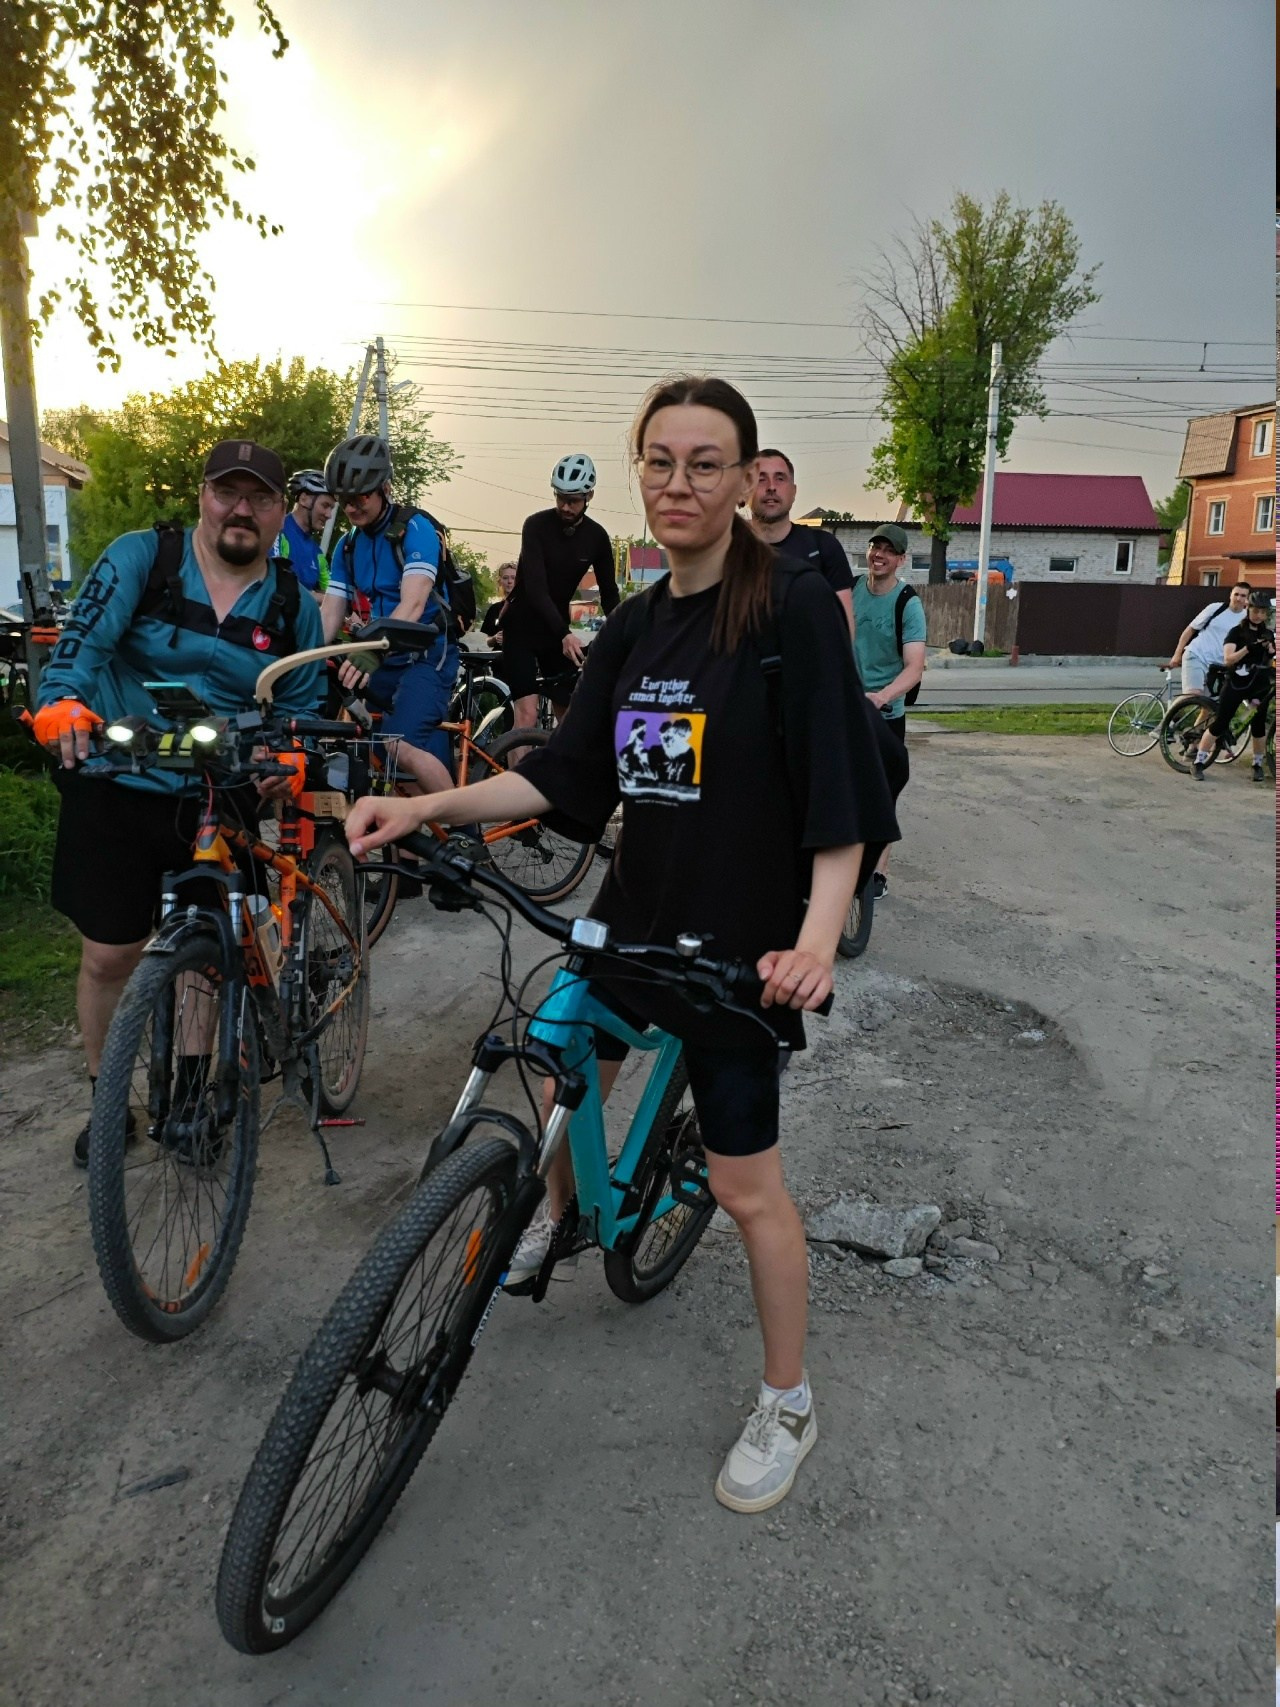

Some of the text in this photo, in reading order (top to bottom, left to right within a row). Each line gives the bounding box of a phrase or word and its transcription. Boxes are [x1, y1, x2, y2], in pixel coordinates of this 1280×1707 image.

[640, 676, 690, 693] Everything
[628, 691, 696, 706] comes together
